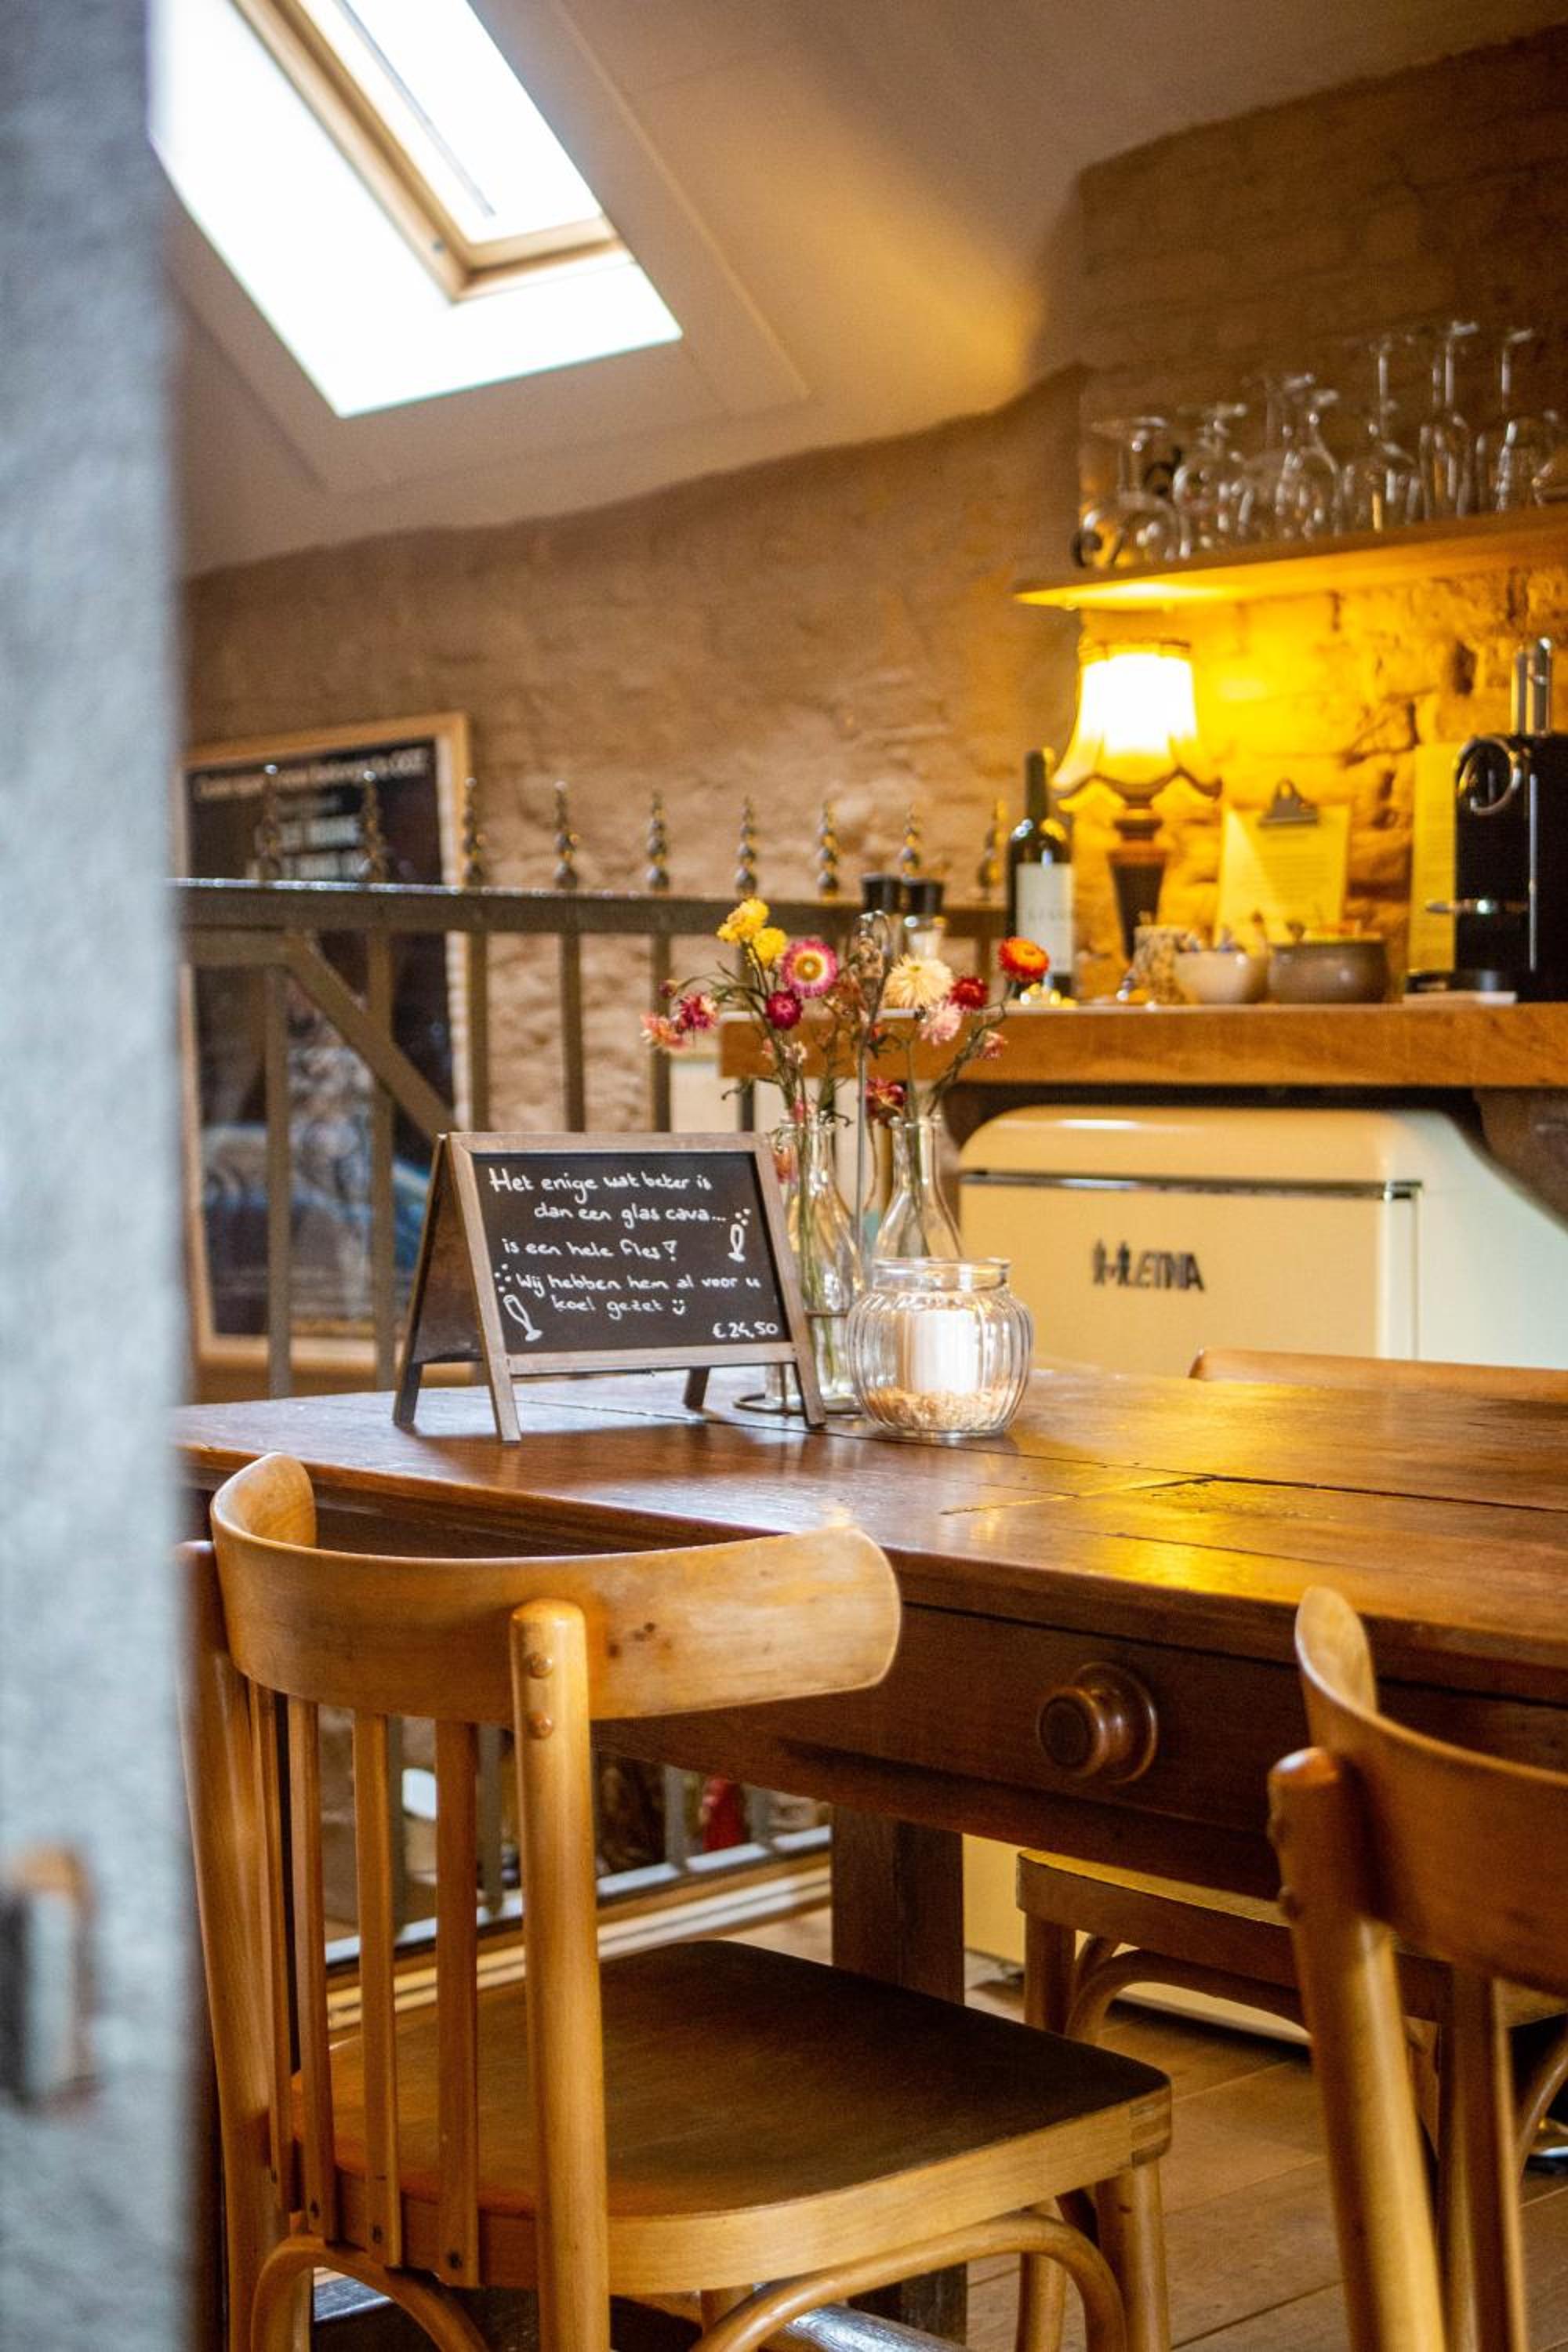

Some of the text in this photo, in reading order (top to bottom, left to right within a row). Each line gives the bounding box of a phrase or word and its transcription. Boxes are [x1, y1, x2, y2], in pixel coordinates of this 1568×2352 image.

[489, 1167, 534, 1191] Het
[541, 1172, 598, 1204] enige
[604, 1174, 641, 1189] wat
[697, 1174, 713, 1191] is
[534, 1202, 573, 1219] dan
[578, 1207, 612, 1220] een
[621, 1203, 660, 1229] glas
[501, 1238, 519, 1254] is
[524, 1243, 562, 1256] een
[566, 1241, 614, 1258] hele
[515, 1272, 761, 1298] Wij hebben hem al voor u
[551, 1295, 663, 1319] koel gezet
